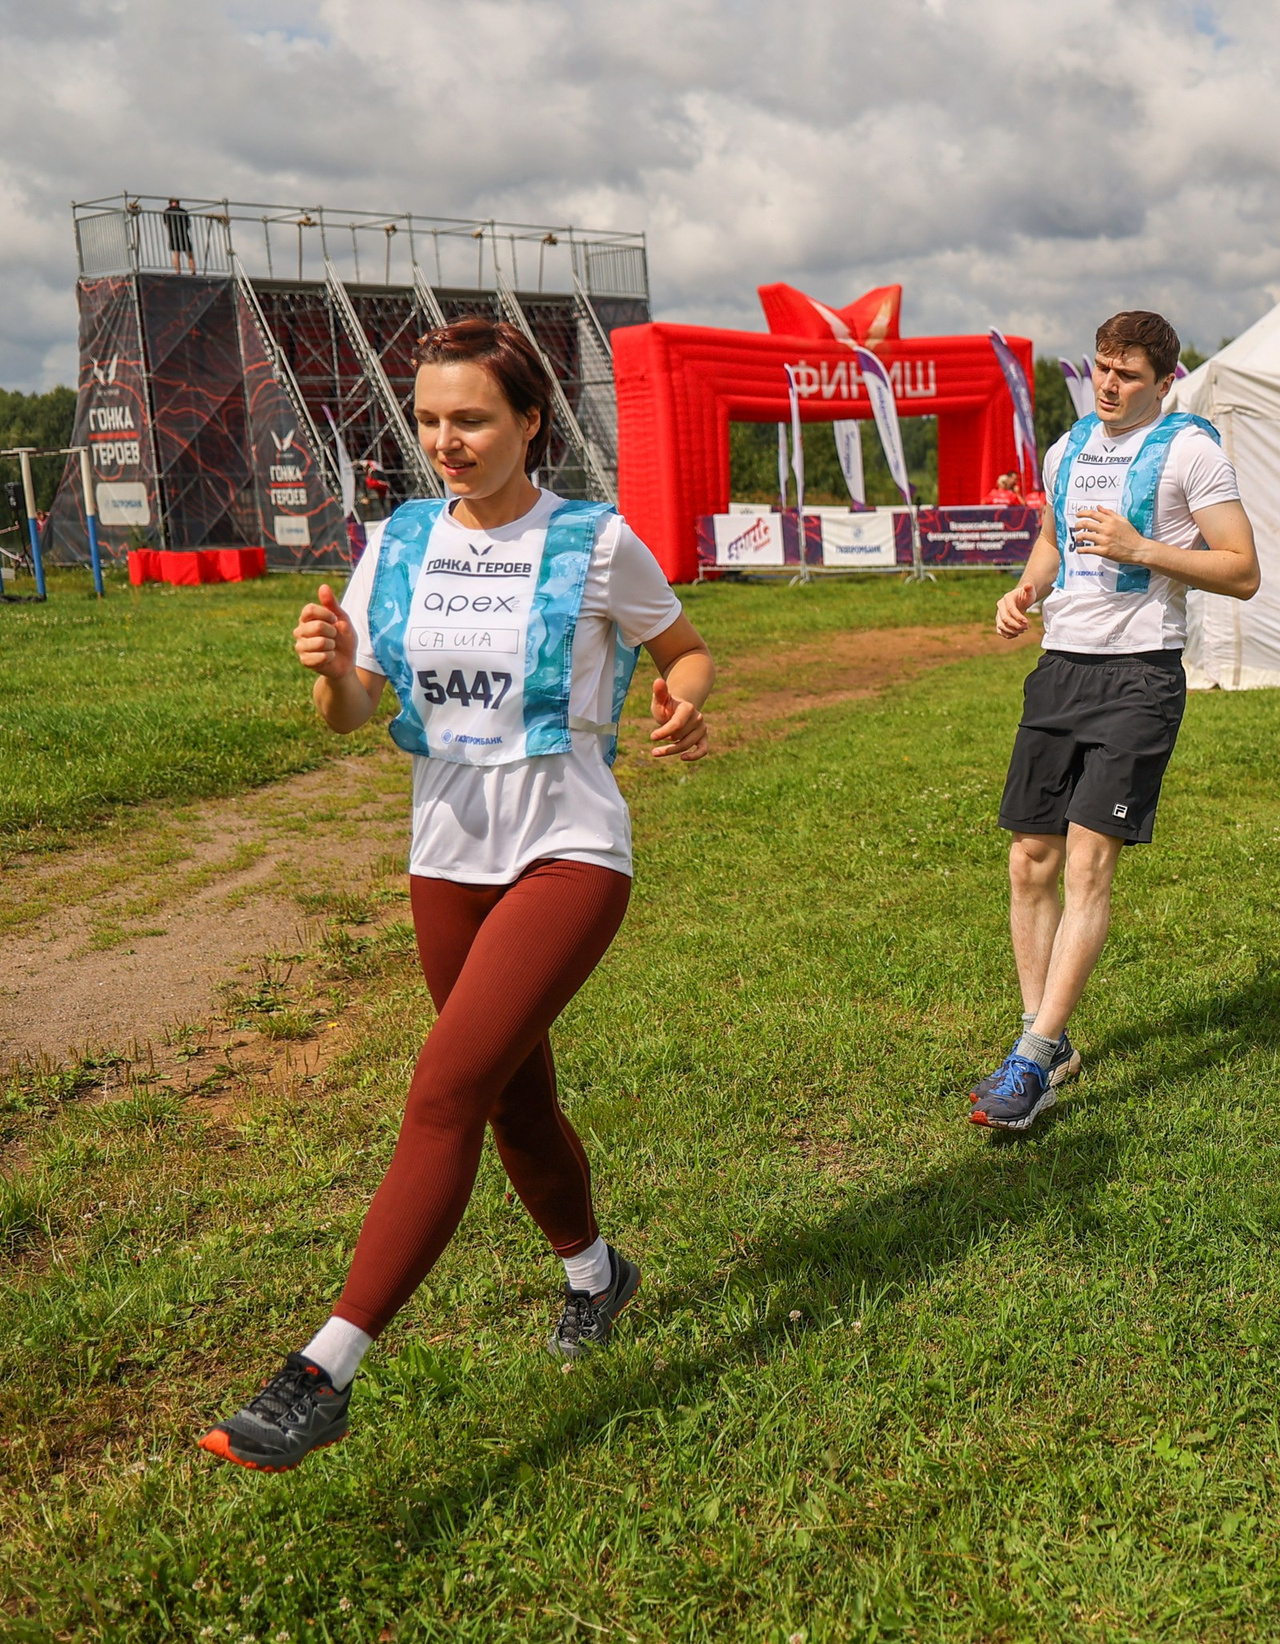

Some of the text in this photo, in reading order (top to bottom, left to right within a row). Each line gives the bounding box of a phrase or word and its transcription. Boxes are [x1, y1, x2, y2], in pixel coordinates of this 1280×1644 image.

[89, 406, 135, 431] ГОНКА
[92, 441, 140, 466] ГЕРОЕВ
[1077, 453, 1132, 464] ГОНКА ГЕРОЕВ
[270, 465, 304, 482] ГОНКА
[271, 488, 308, 505] ГЕРОЕВ
[426, 558, 532, 574] ГОНКА ГЕРОЕВ
[417, 669, 513, 710] 5447
[455, 734, 504, 745] ГАЗПРОМБАНК
